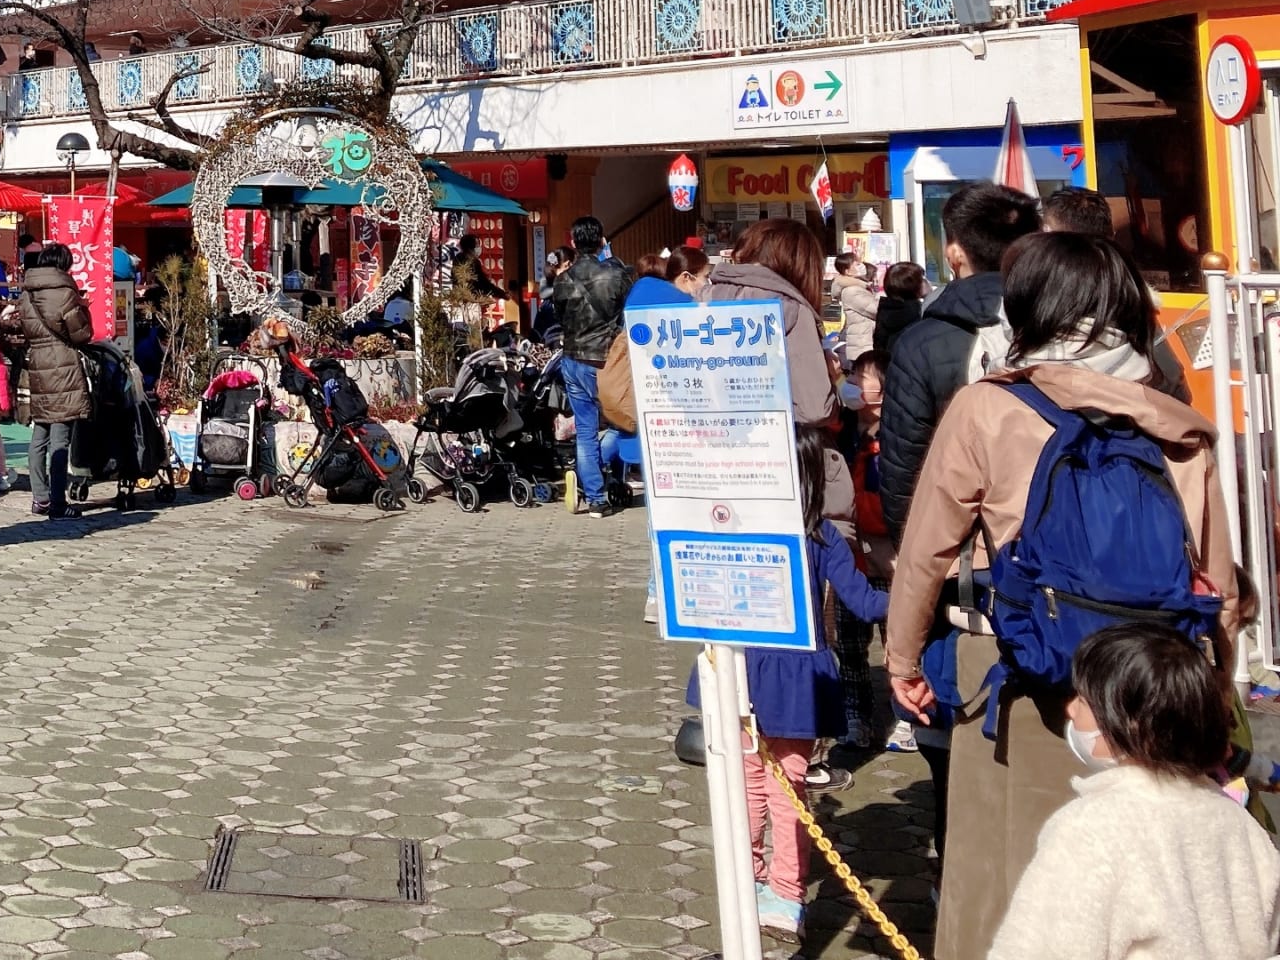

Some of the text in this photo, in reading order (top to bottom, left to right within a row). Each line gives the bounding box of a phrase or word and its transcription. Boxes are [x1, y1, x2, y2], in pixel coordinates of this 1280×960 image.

[1216, 56, 1240, 85] 入口
[757, 109, 821, 123] トイレ TOILET
[321, 130, 372, 175] 花
[727, 165, 789, 196] Food
[673, 187, 691, 208] 氷
[67, 208, 95, 240] 浅草
[656, 313, 776, 349] メリーゴーランド
[668, 353, 768, 371] Merry-go-round
[646, 377, 704, 390] のりもの券 3枚
[675, 551, 786, 564] 浅草花やしきからのお願いと取り組み
